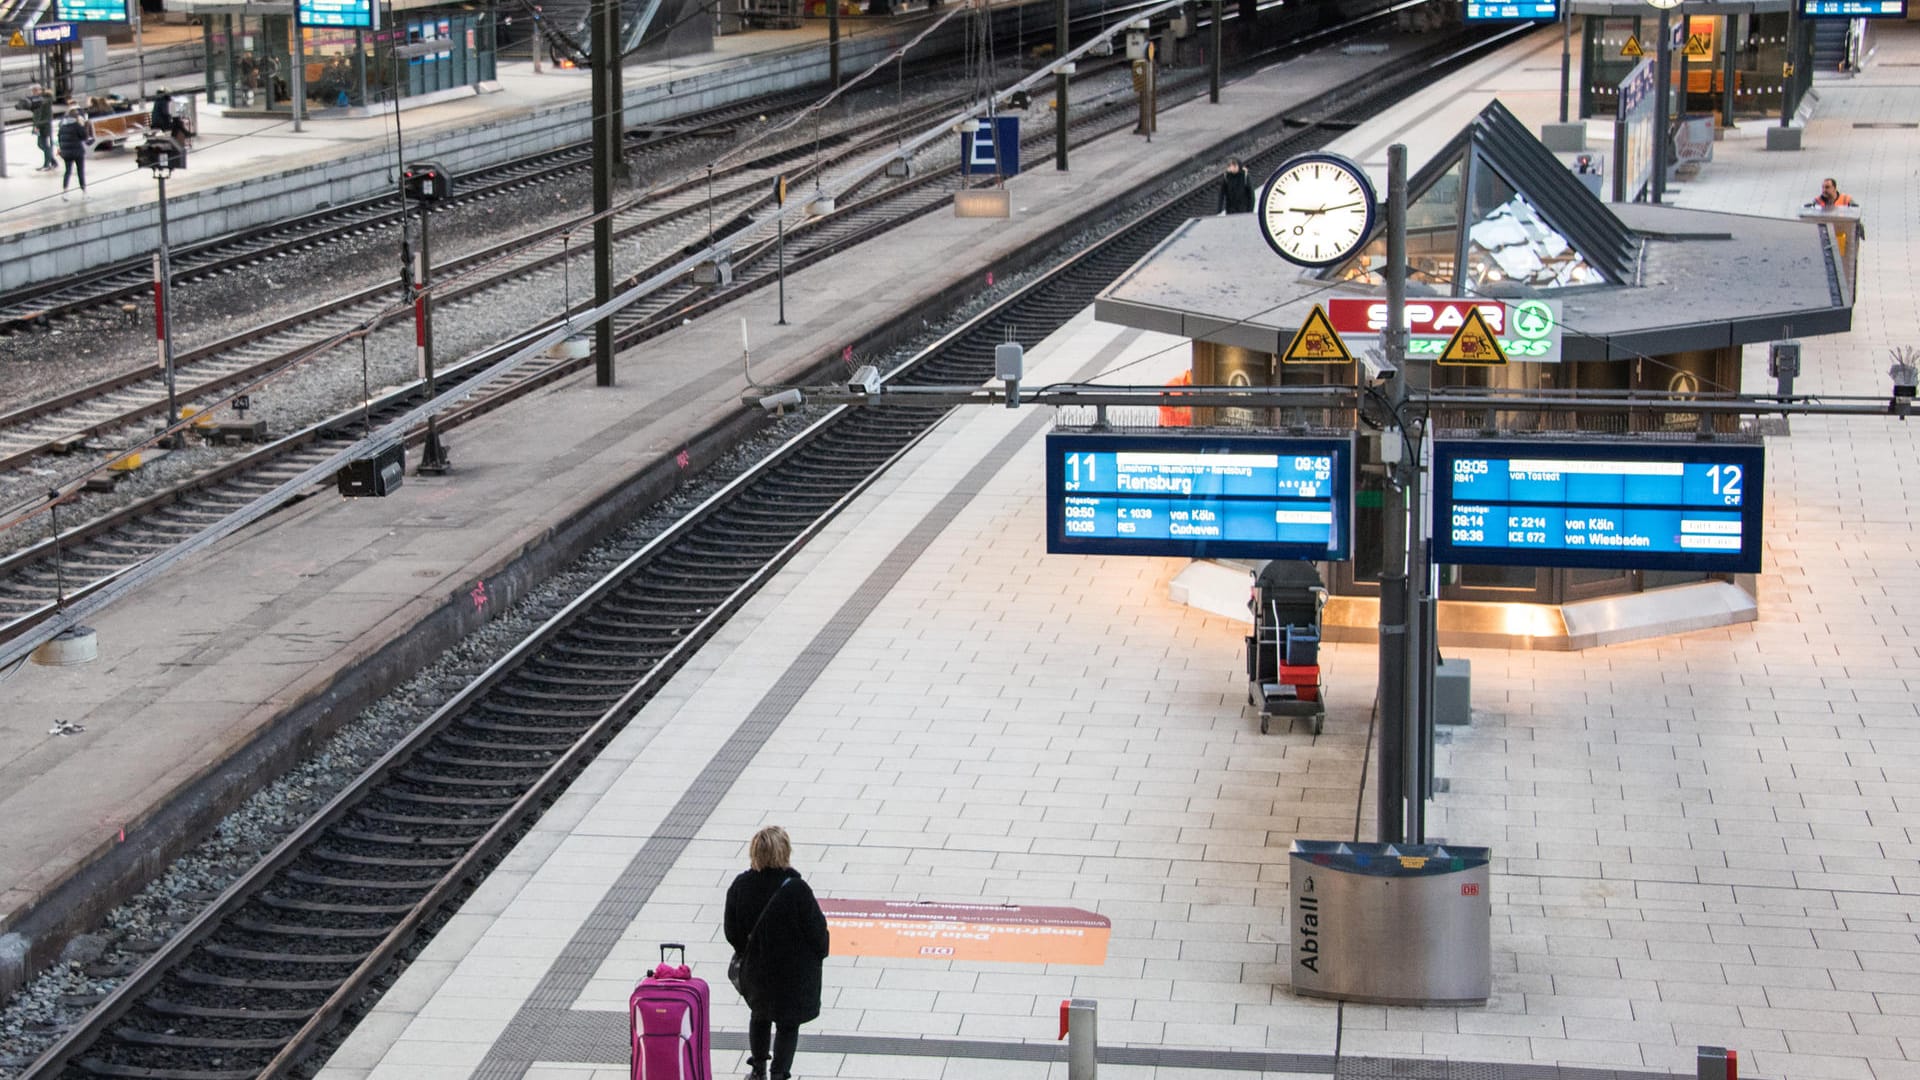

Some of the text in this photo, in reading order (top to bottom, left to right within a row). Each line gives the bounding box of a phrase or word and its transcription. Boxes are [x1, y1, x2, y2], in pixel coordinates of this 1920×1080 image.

[971, 122, 996, 165] E
[1367, 304, 1503, 331] SPAR
[1066, 453, 1095, 482] 11
[1295, 457, 1331, 470] 09:43
[1454, 460, 1488, 474] 09:05
[1509, 472, 1526, 480] von
[1706, 464, 1742, 495] 12
[1117, 474, 1192, 494] Flensburg
[1065, 506, 1095, 518] 09:50
[1117, 508, 1127, 518] IC
[1170, 511, 1189, 520] von
[1192, 509, 1215, 521] Köln
[1066, 521, 1095, 532] 10:05
[1170, 523, 1219, 536] Cuxhaven
[1452, 515, 1614, 530] 09:14 IC 2214 von Köln
[1508, 531, 1524, 543] ICE
[1526, 532, 1546, 543] 672
[1565, 535, 1585, 544] von
[1589, 533, 1650, 546] Wiesbaden
[1461, 883, 1479, 896] DB
[1300, 897, 1318, 973] Abfall
